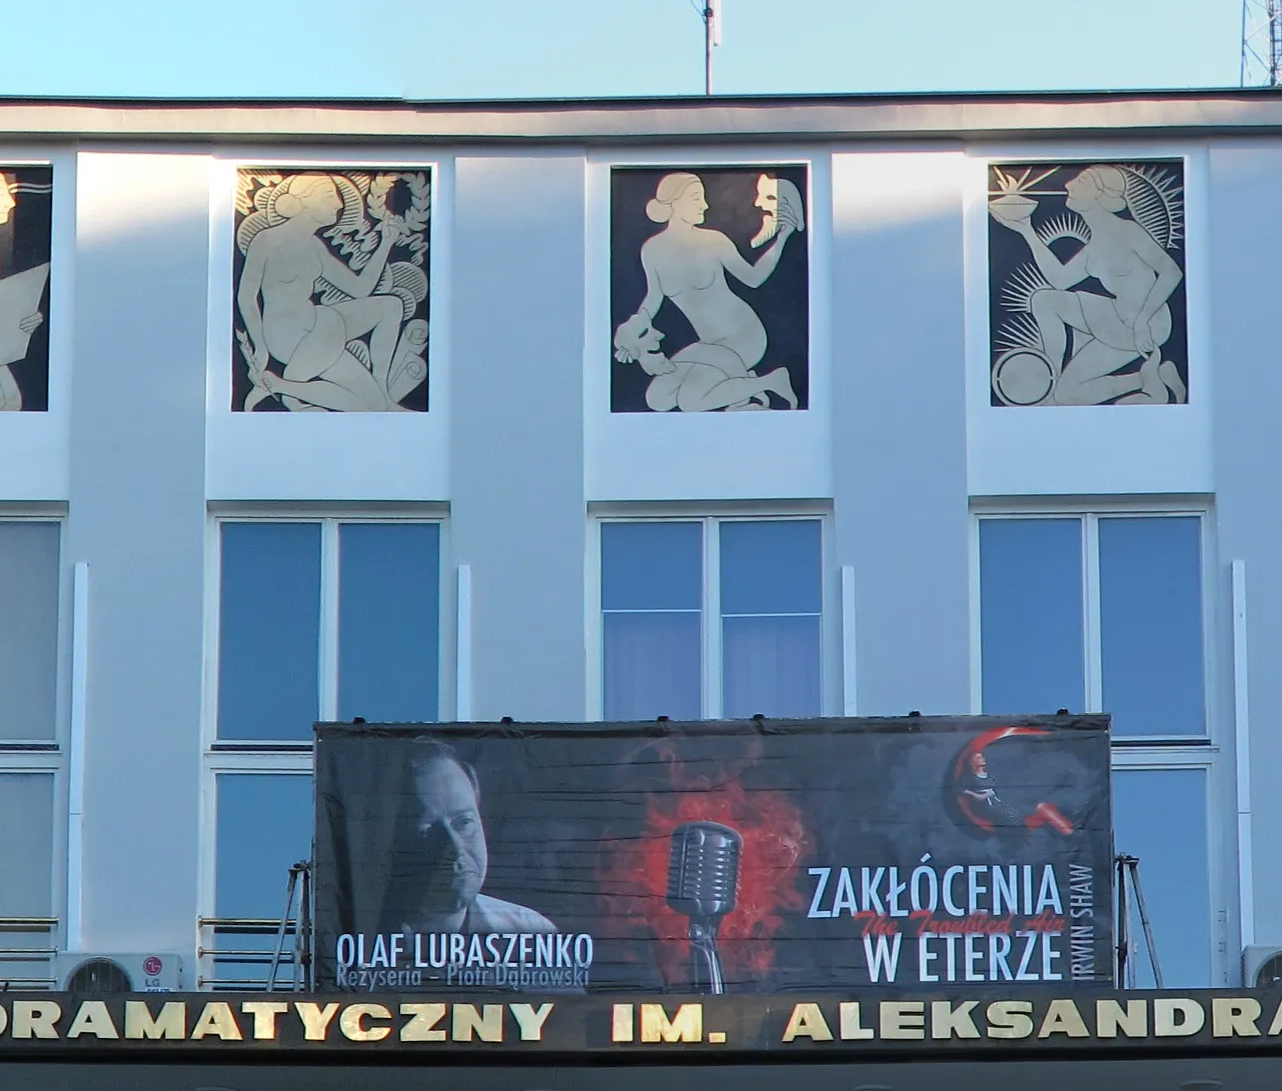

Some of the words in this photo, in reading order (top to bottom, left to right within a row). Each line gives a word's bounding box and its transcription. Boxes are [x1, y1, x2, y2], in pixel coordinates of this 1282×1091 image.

[807, 852, 1065, 918] ZAKŁÓCENIA
[1069, 863, 1095, 918] SHAW
[853, 910, 899, 936] The
[909, 909, 1016, 937] Troubled
[1023, 908, 1067, 934] Air
[336, 933, 404, 968] OLAF
[414, 933, 594, 968] LUBASZENKO
[863, 931, 903, 983] W
[919, 930, 1063, 983] ETERZE
[1071, 925, 1096, 982] IRWIN
[145, 978, 161, 988] LG
[446, 963, 489, 987] Piotr
[495, 963, 590, 991] Dąbrowski
[611, 1002, 727, 1043] IM.
